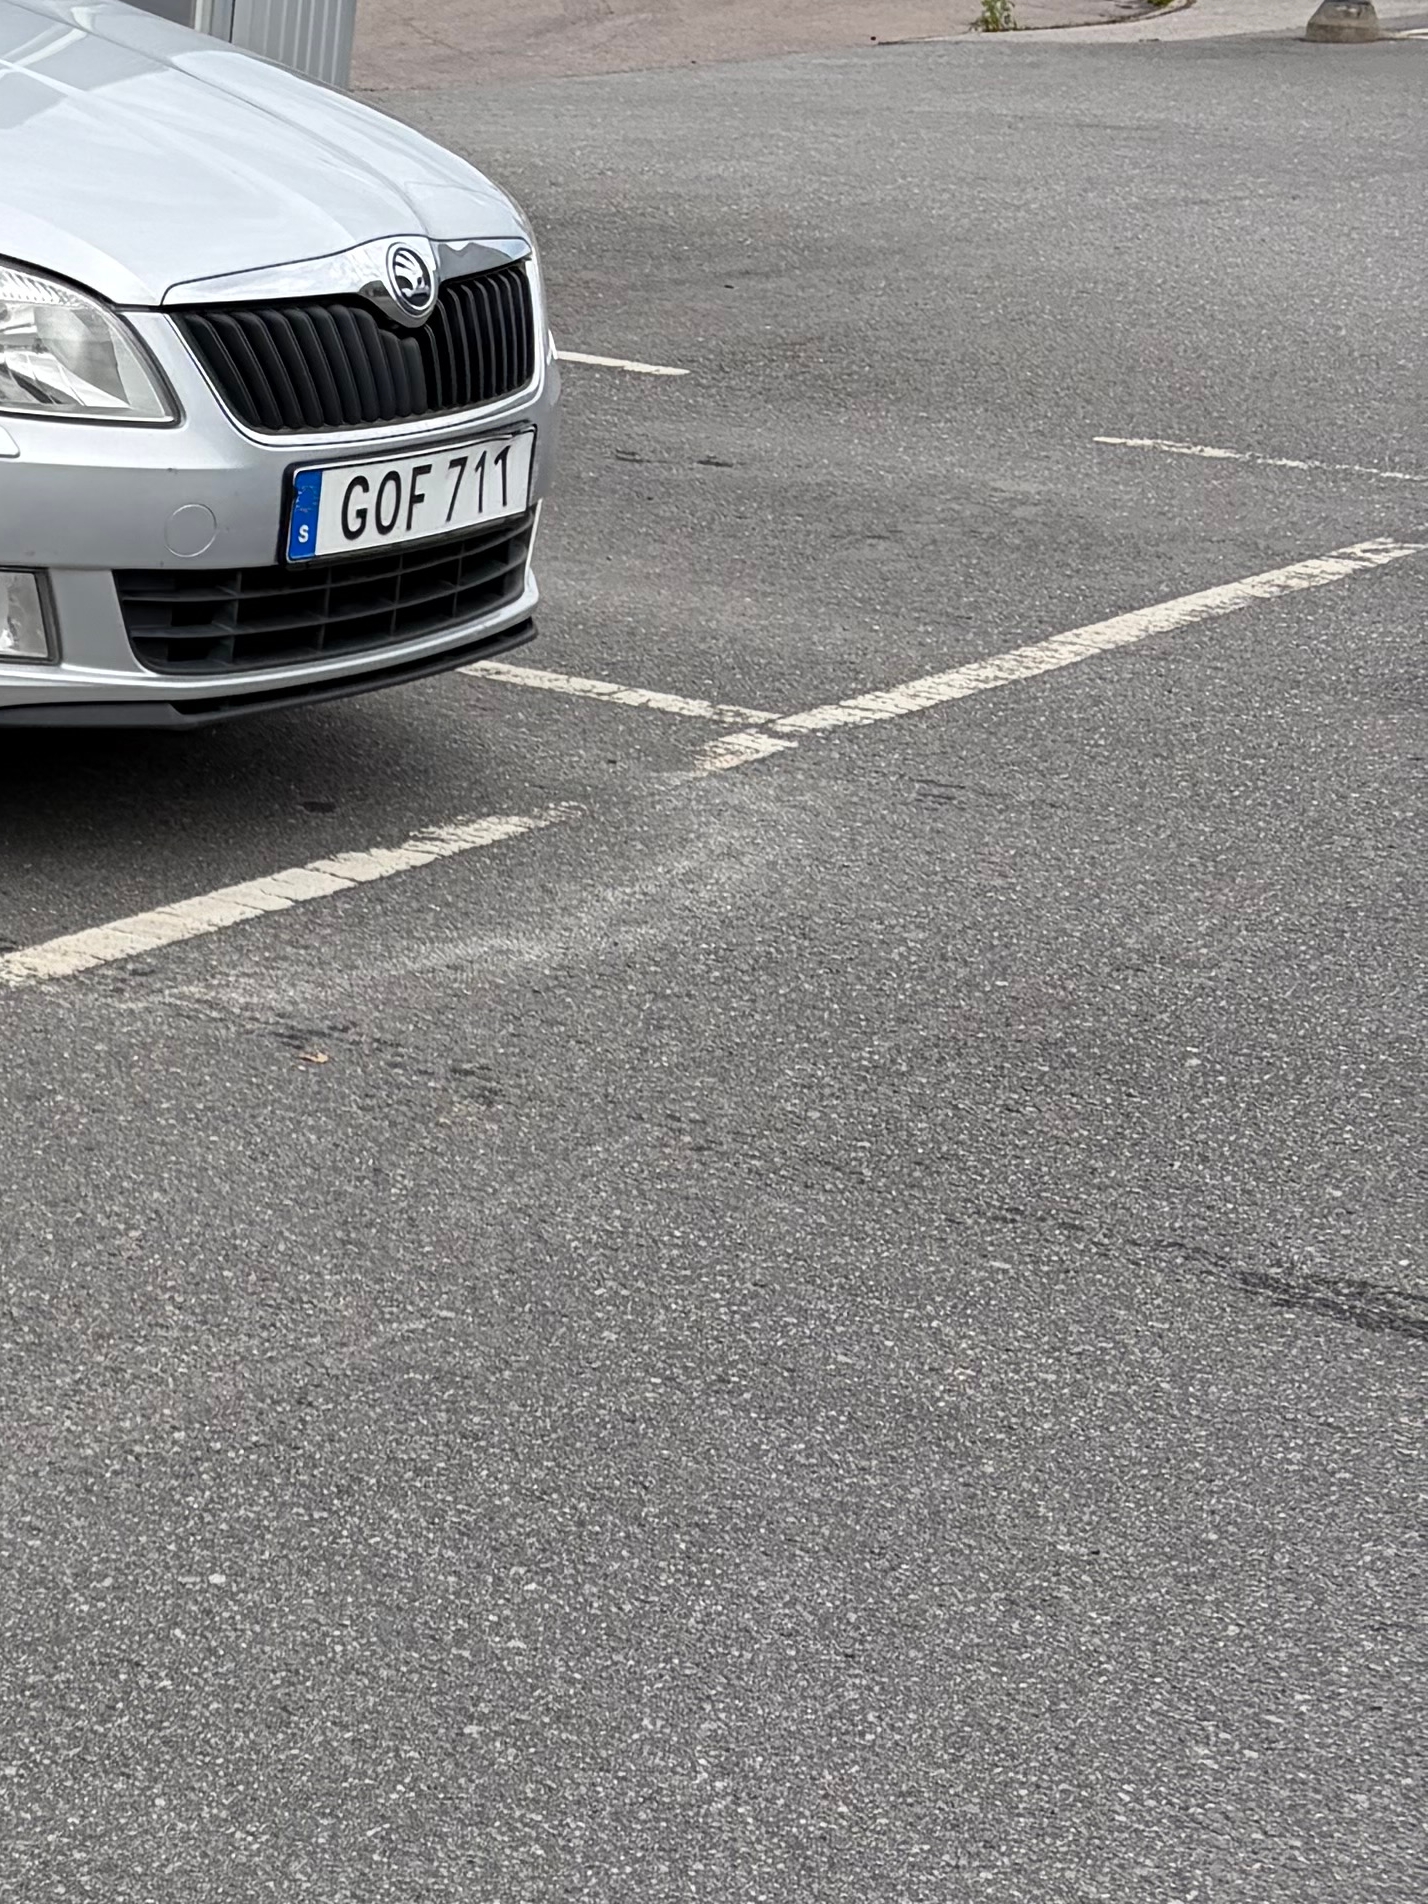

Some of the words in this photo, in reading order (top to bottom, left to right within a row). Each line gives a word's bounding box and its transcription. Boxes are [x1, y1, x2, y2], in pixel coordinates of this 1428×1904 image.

[341, 463, 433, 541] GOF
[445, 445, 512, 523] 711
[297, 524, 310, 543] S
